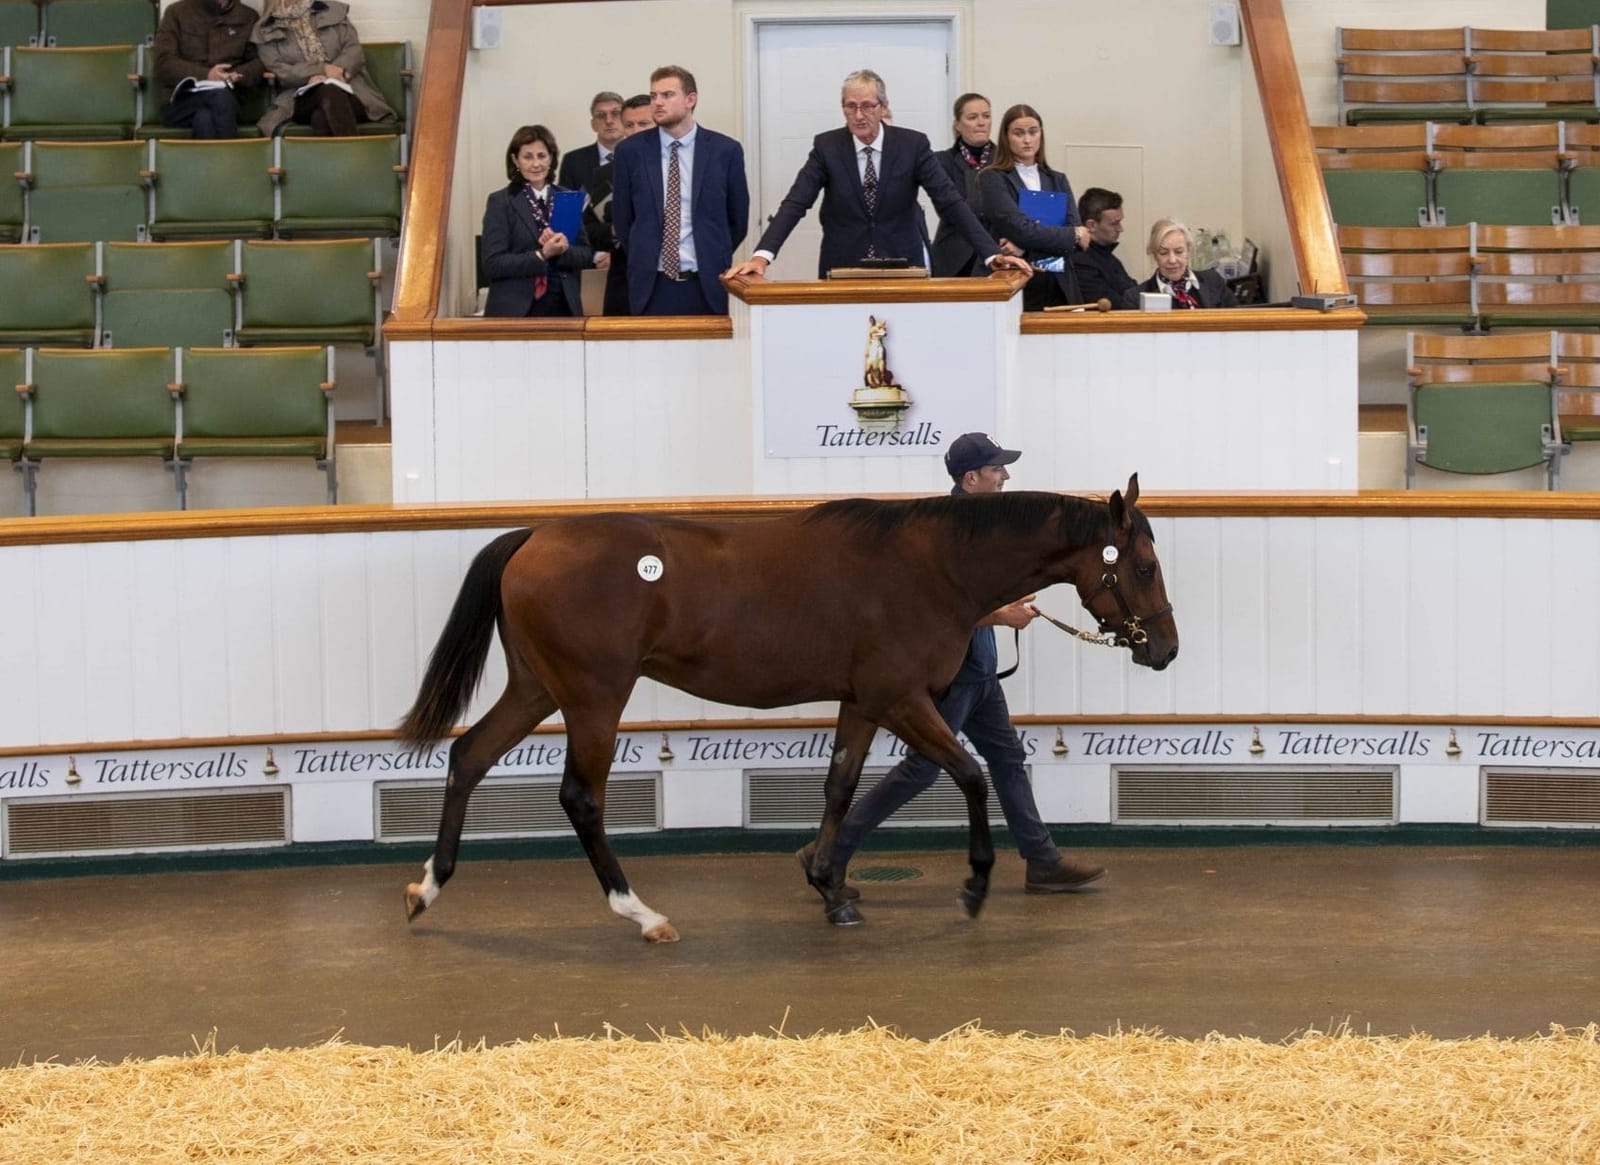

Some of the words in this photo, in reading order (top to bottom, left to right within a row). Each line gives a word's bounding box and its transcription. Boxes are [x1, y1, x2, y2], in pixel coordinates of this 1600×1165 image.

[817, 422, 941, 447] Tattersalls
[643, 564, 658, 575] 477
[1081, 730, 1234, 756] Tattersalls
[1278, 730, 1431, 756] Tattersalls
[95, 752, 248, 783] Tattersalls
[294, 744, 447, 774] Tattersalls
